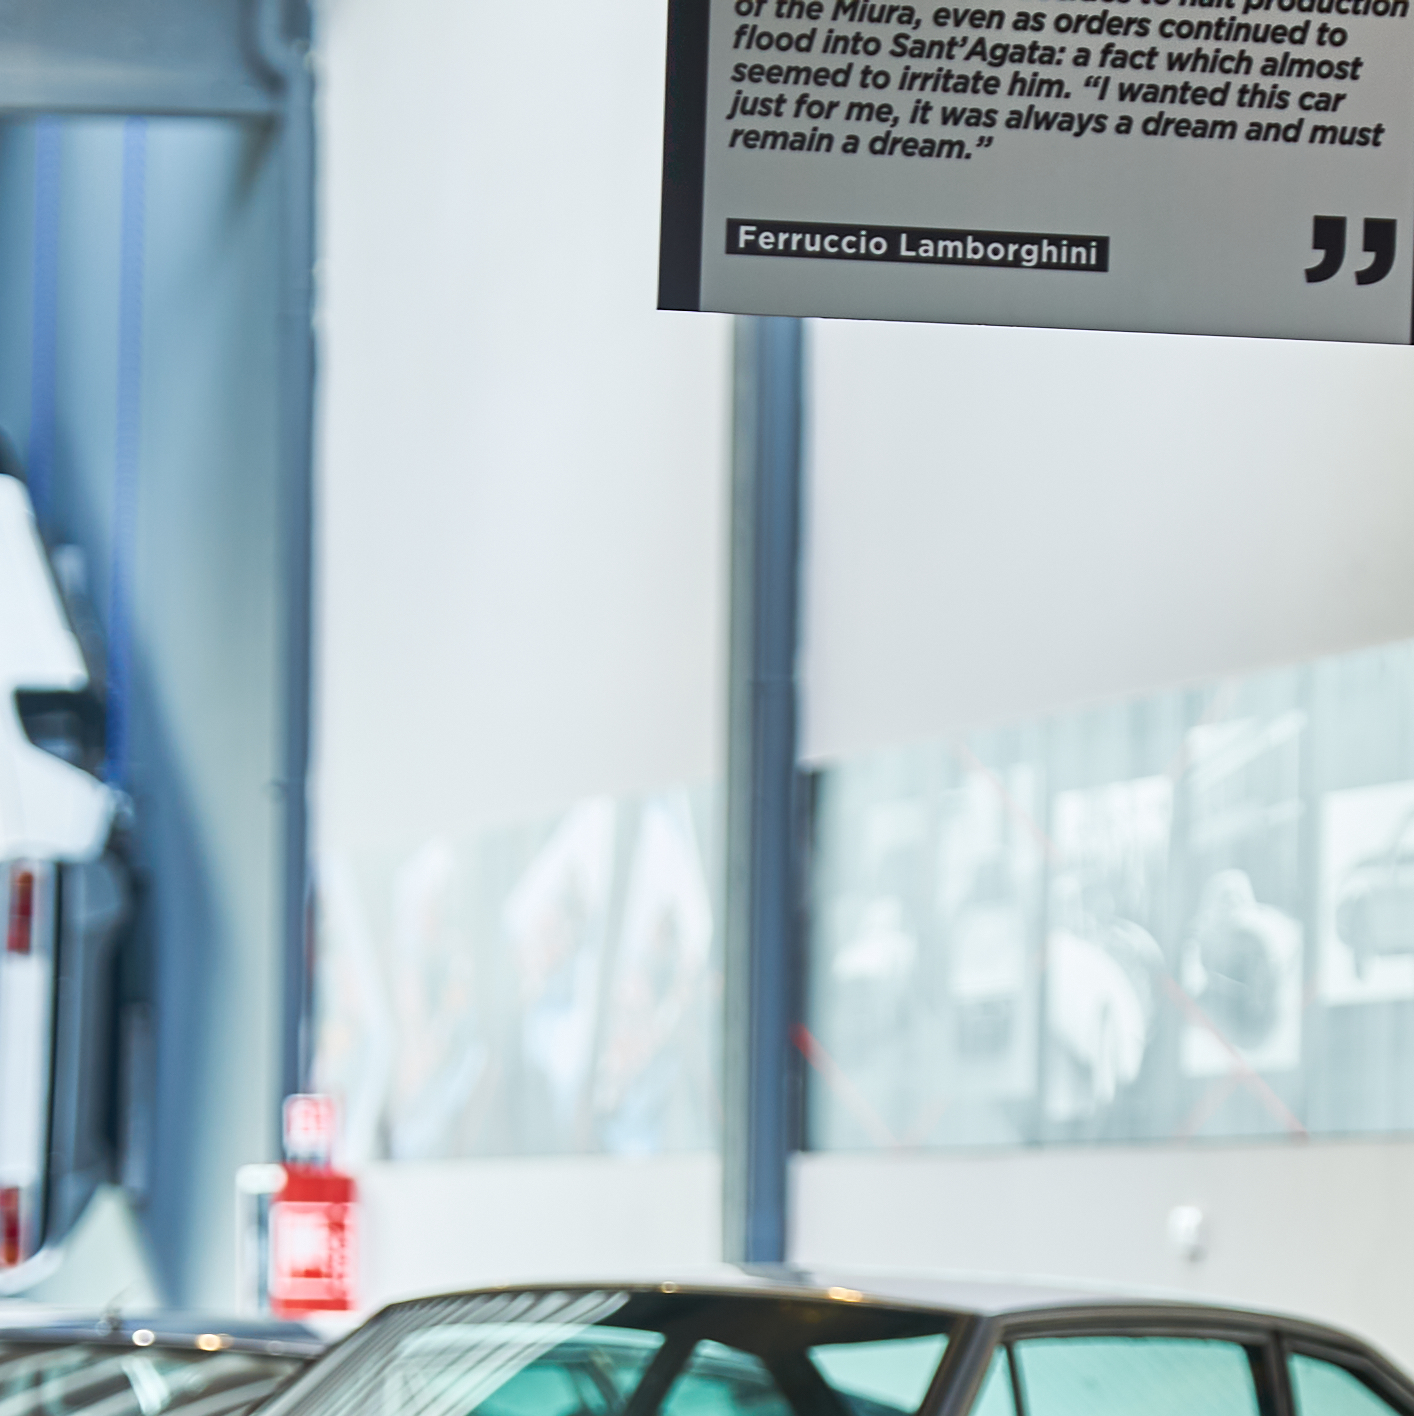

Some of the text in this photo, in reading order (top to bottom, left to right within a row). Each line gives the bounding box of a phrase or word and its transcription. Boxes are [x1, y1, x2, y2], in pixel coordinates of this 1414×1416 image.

[734, 0, 1348, 47] of the Miura, even as orders continued to
[733, 24, 1364, 80] flood into Sant’Agata: a fact which almost
[730, 62, 1347, 112] seemed to irritate him. “I wanted this car
[725, 89, 1385, 147] just for me, it was always a dream and must
[728, 126, 994, 160] remain a dream.”
[738, 224, 1097, 267] Ferruccio Lamborghini
